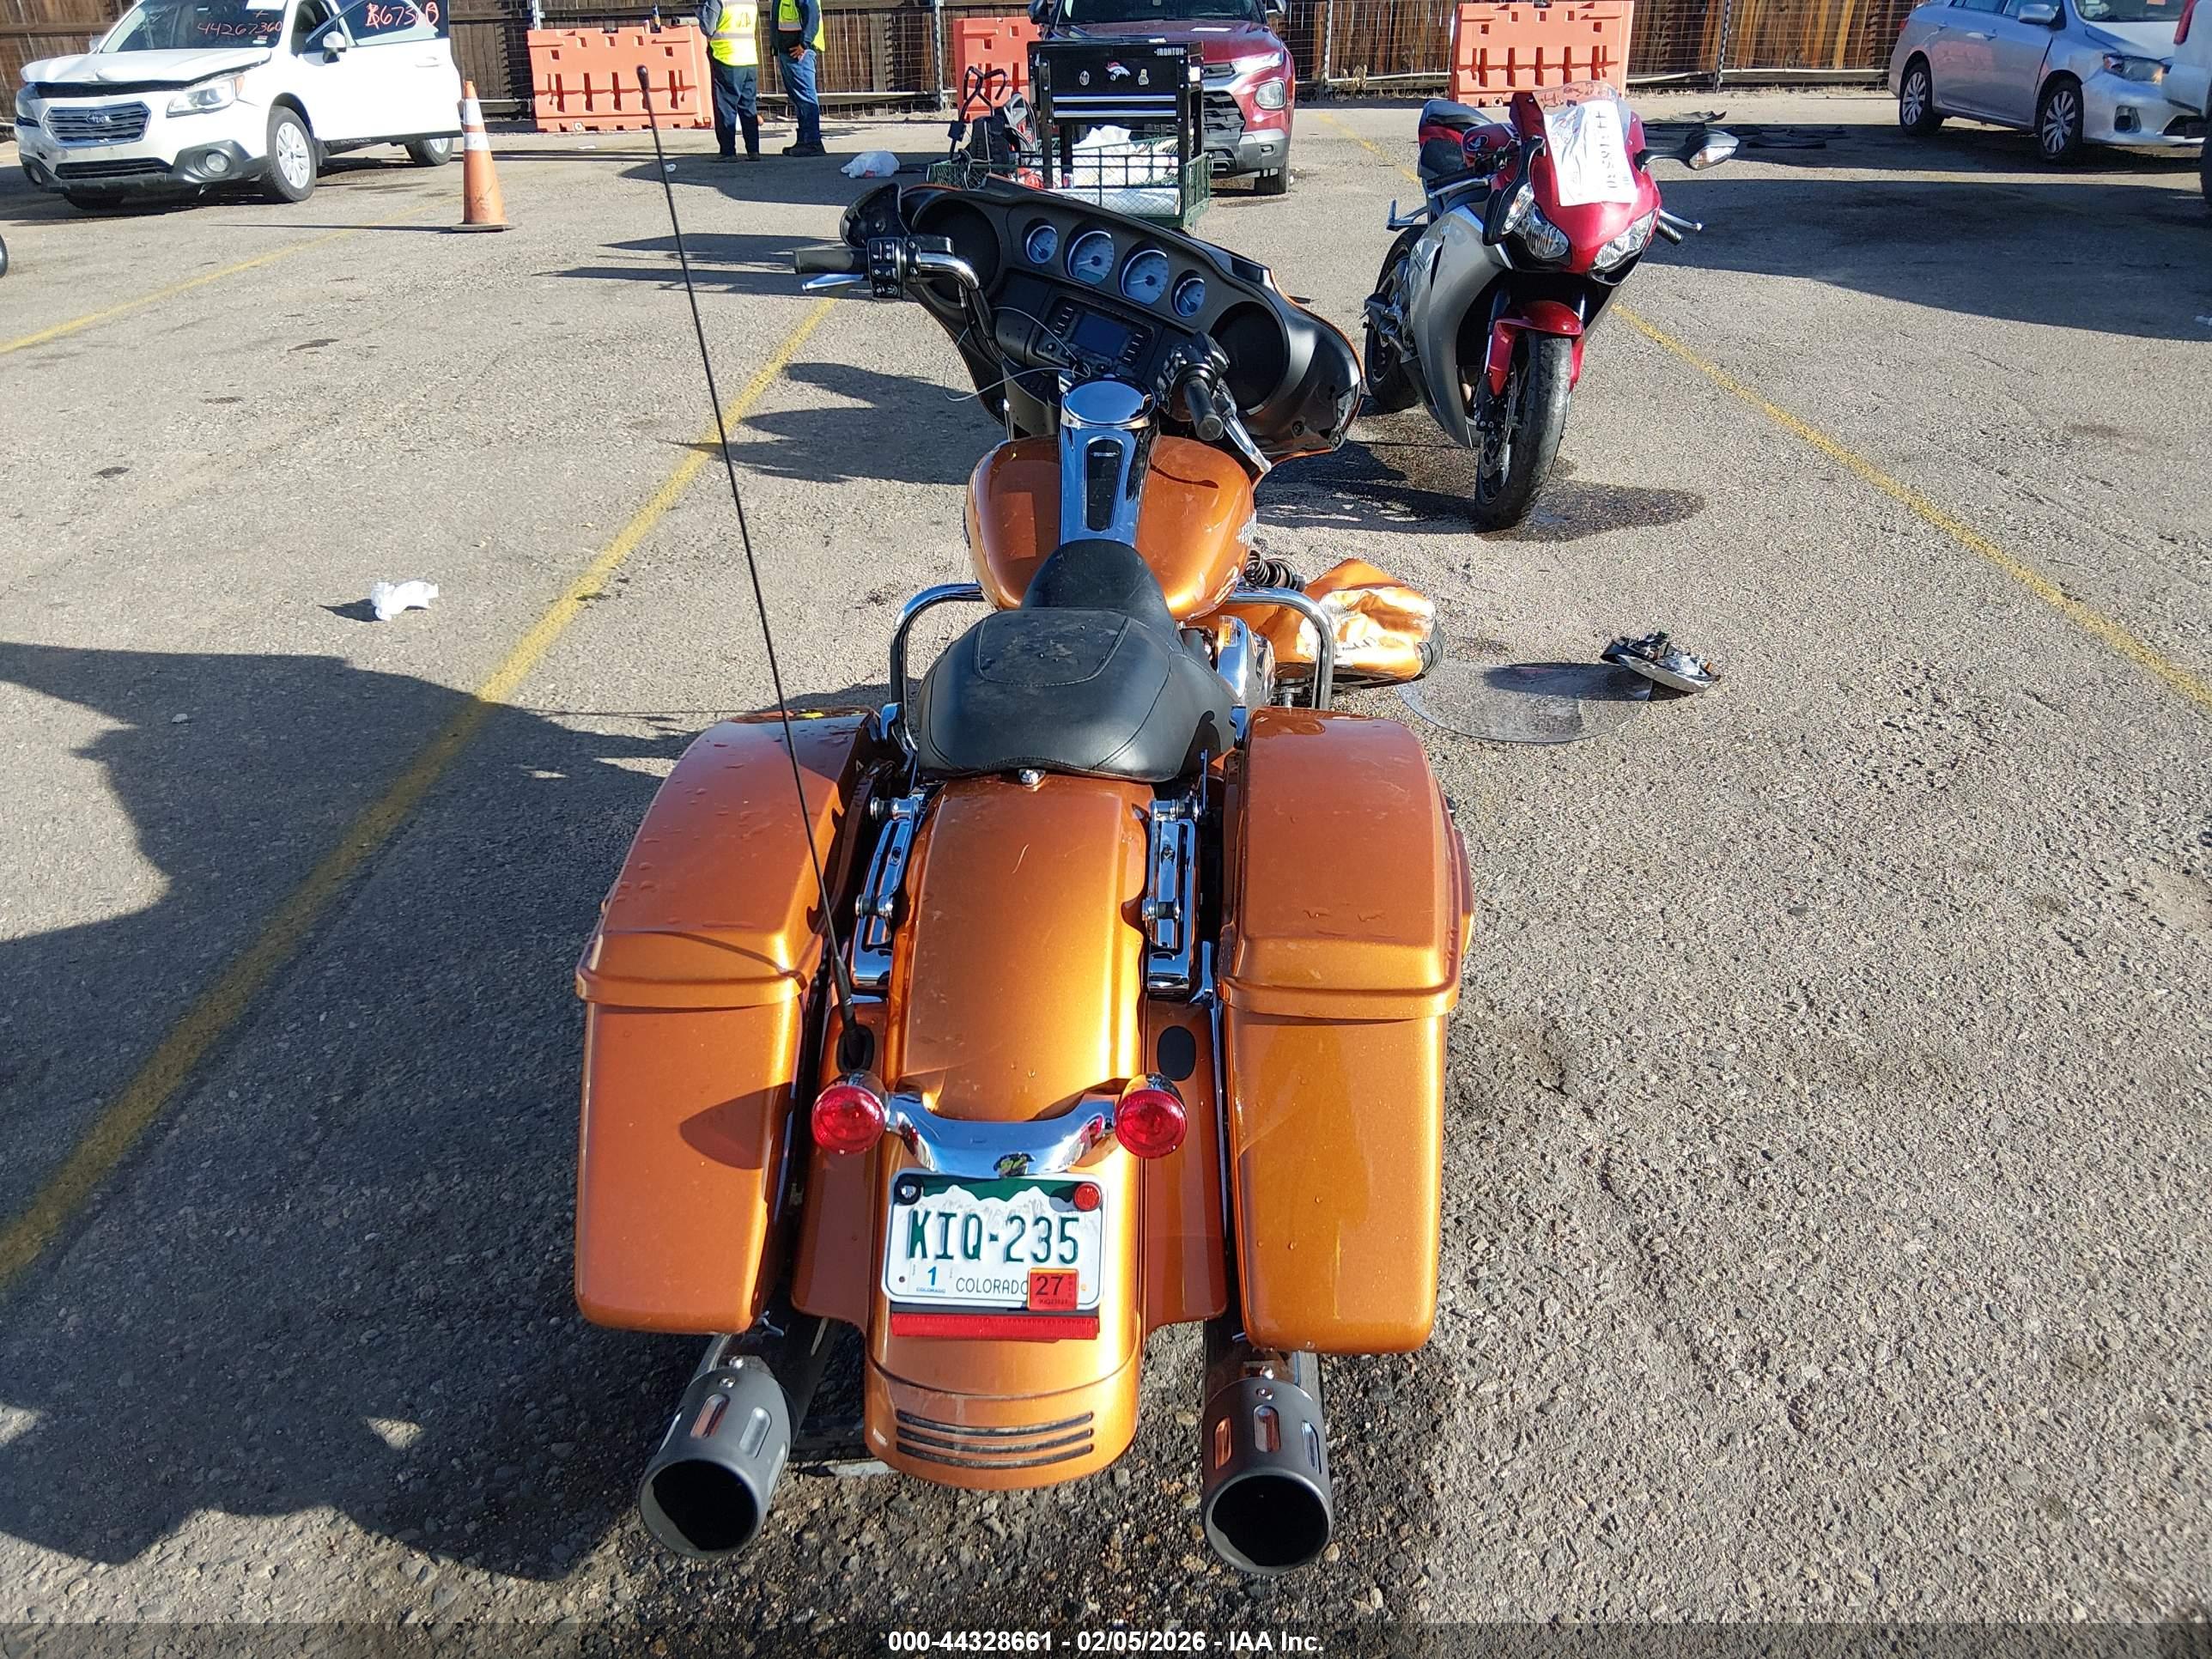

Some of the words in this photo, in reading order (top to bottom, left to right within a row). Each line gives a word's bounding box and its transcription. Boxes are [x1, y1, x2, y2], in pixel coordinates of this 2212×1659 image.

[197, 21, 283, 36] 44267360
[1157, 47, 1184, 57] IRONTON
[907, 1209, 1079, 1265] KIQ-235
[927, 1266, 937, 1285] 1
[1036, 1276, 1064, 1296] 27
